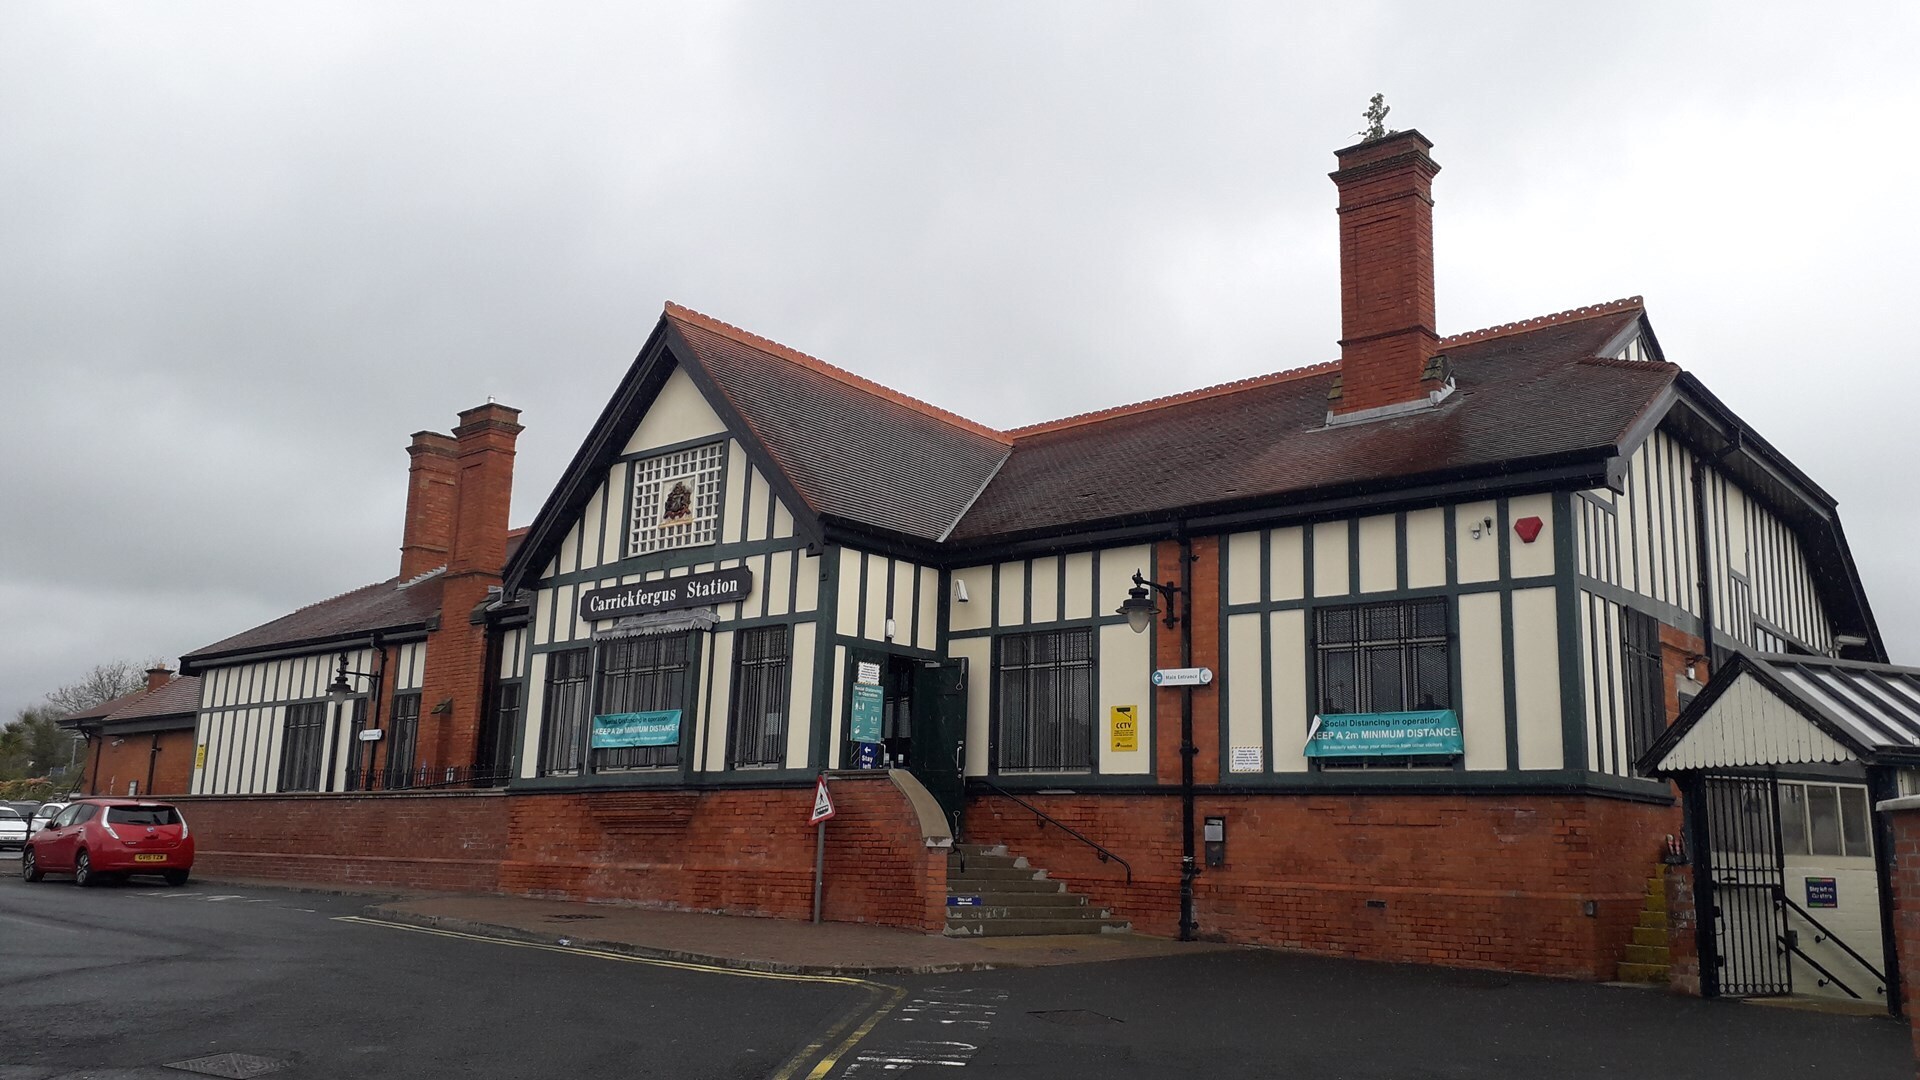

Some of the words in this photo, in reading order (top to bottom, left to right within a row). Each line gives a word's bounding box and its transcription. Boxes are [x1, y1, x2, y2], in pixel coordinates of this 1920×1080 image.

[589, 587, 677, 612] Carrickfergus
[686, 578, 738, 599] Station
[1324, 718, 1348, 727] Social
[1349, 717, 1391, 728] Distancing
[1392, 716, 1400, 726] in
[1402, 716, 1440, 727] operation
[595, 727, 611, 735] KEEP
[624, 724, 649, 734] MINIMUM
[649, 723, 676, 733] DISTANCE
[1336, 731, 1344, 740] A
[1345, 730, 1359, 739] 2m
[1361, 729, 1404, 739] MINIMUM
[1407, 727, 1458, 738] DISTANCE
